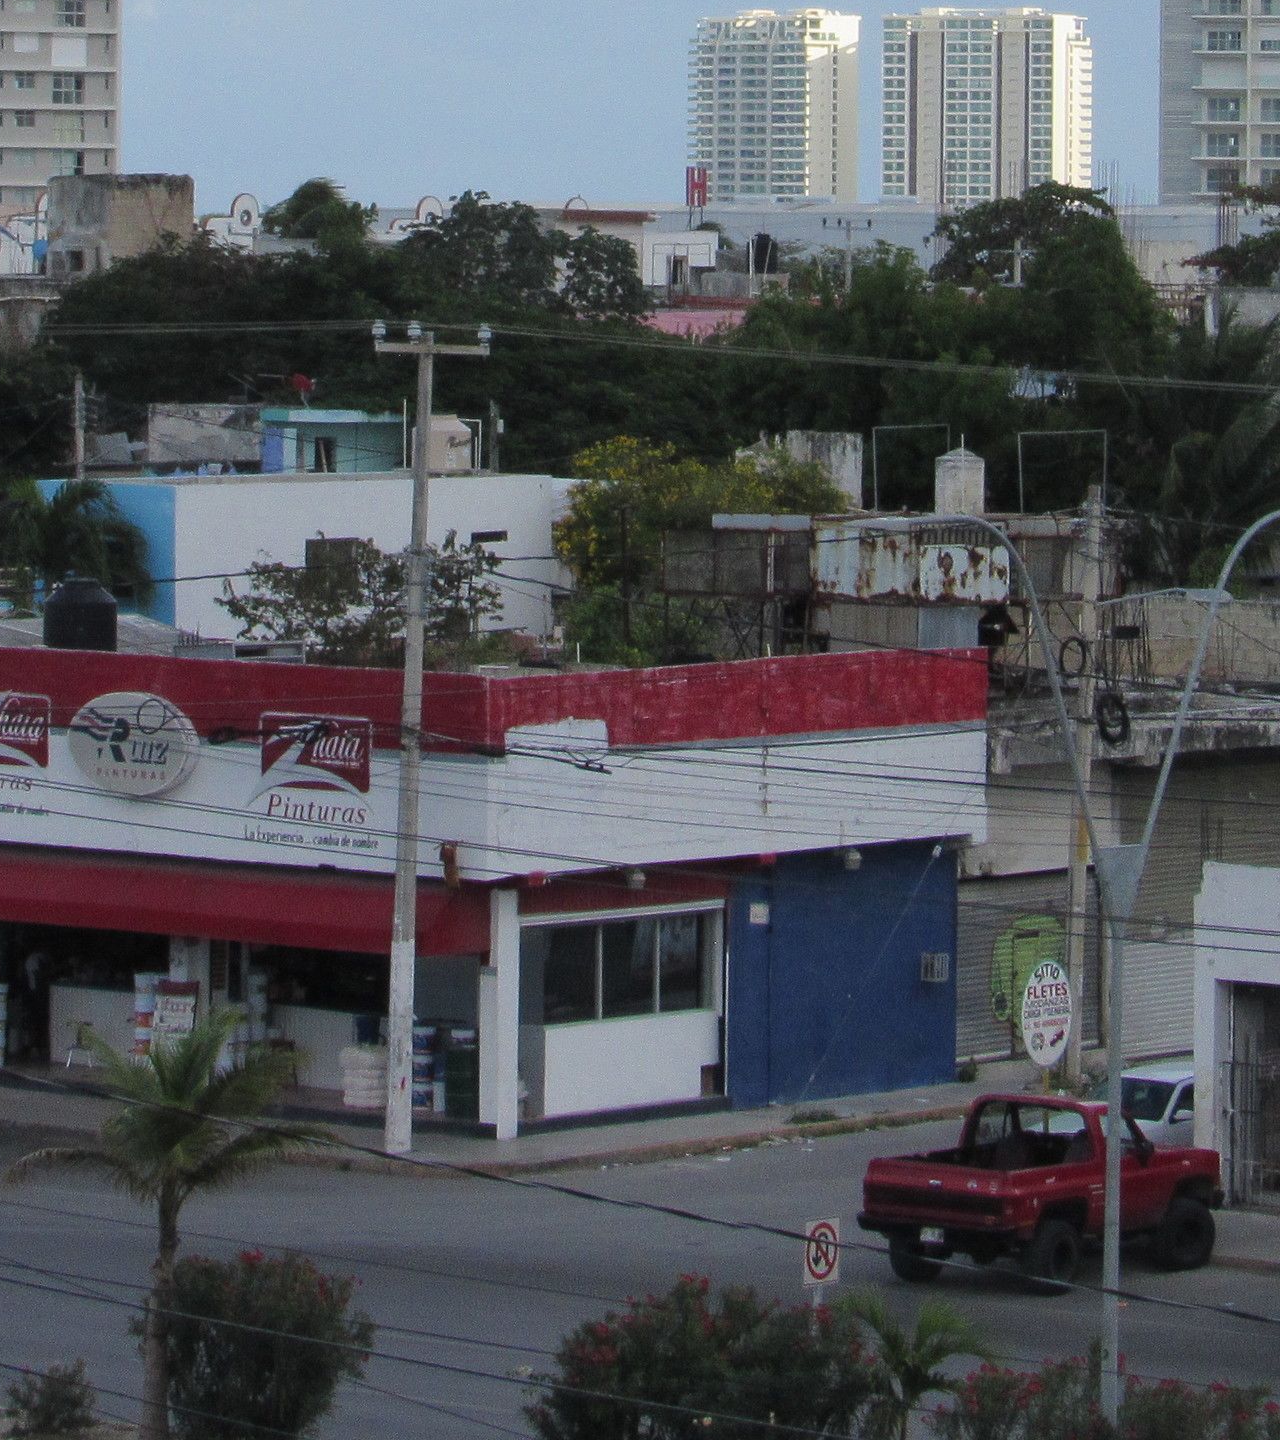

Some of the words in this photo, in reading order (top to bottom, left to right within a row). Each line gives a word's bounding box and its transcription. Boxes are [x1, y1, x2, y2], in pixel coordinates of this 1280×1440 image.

[266, 792, 367, 825] Pinturas
[1033, 963, 1061, 985] SITIO
[1026, 981, 1069, 1000] FLETES
